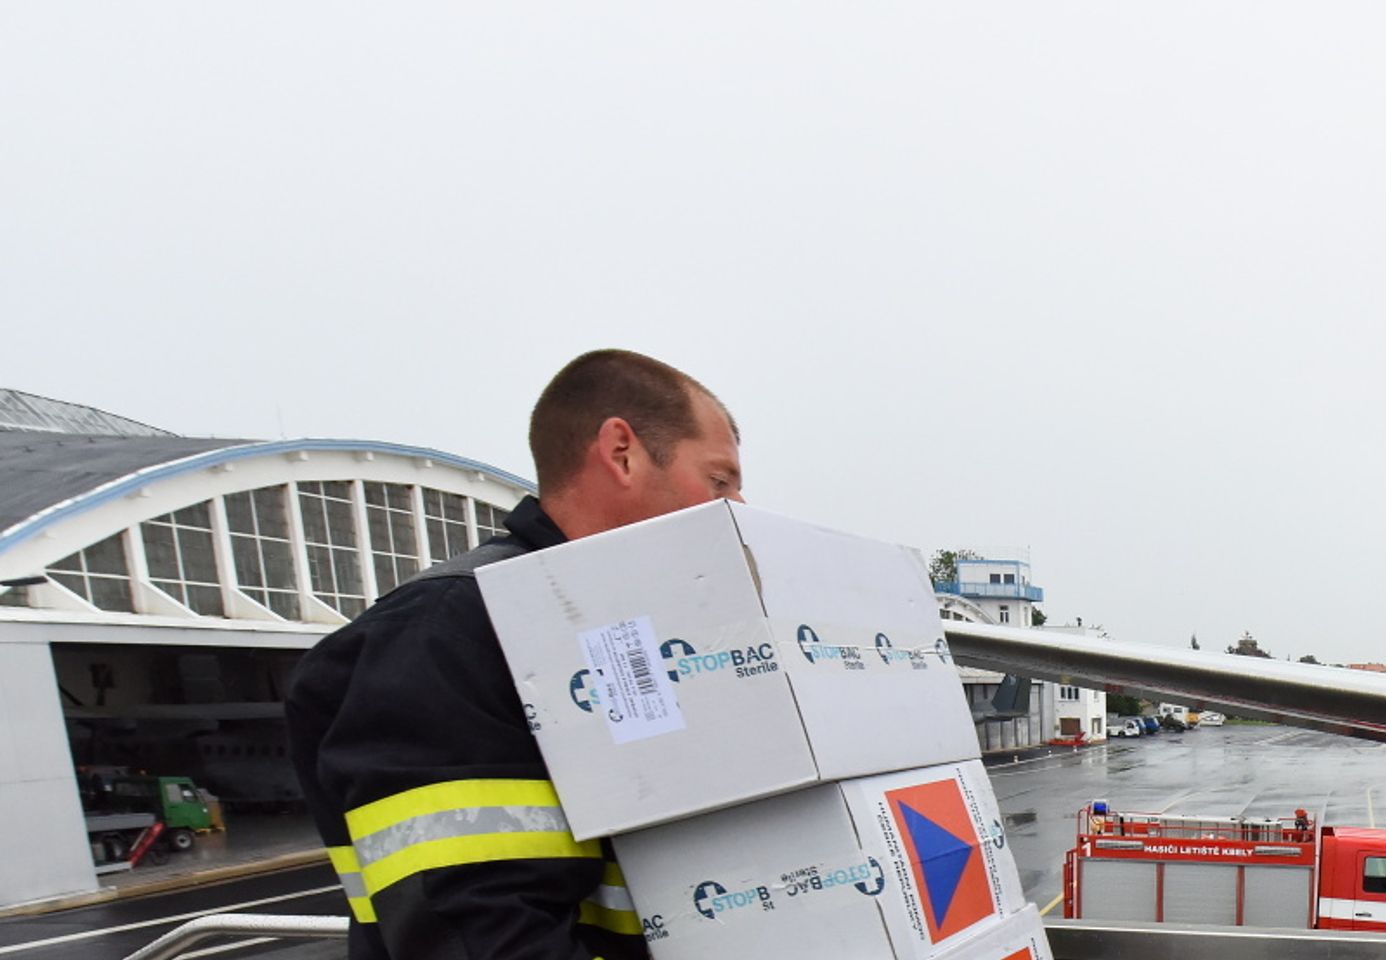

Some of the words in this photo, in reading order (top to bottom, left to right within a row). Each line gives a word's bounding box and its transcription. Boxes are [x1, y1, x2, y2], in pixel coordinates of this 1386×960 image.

[677, 642, 774, 675] STOPBAC
[736, 661, 778, 679] Sterile
[1082, 842, 1092, 857] 1
[1144, 844, 1178, 854] HASIČI
[1180, 845, 1219, 856] LETIŠTĚ
